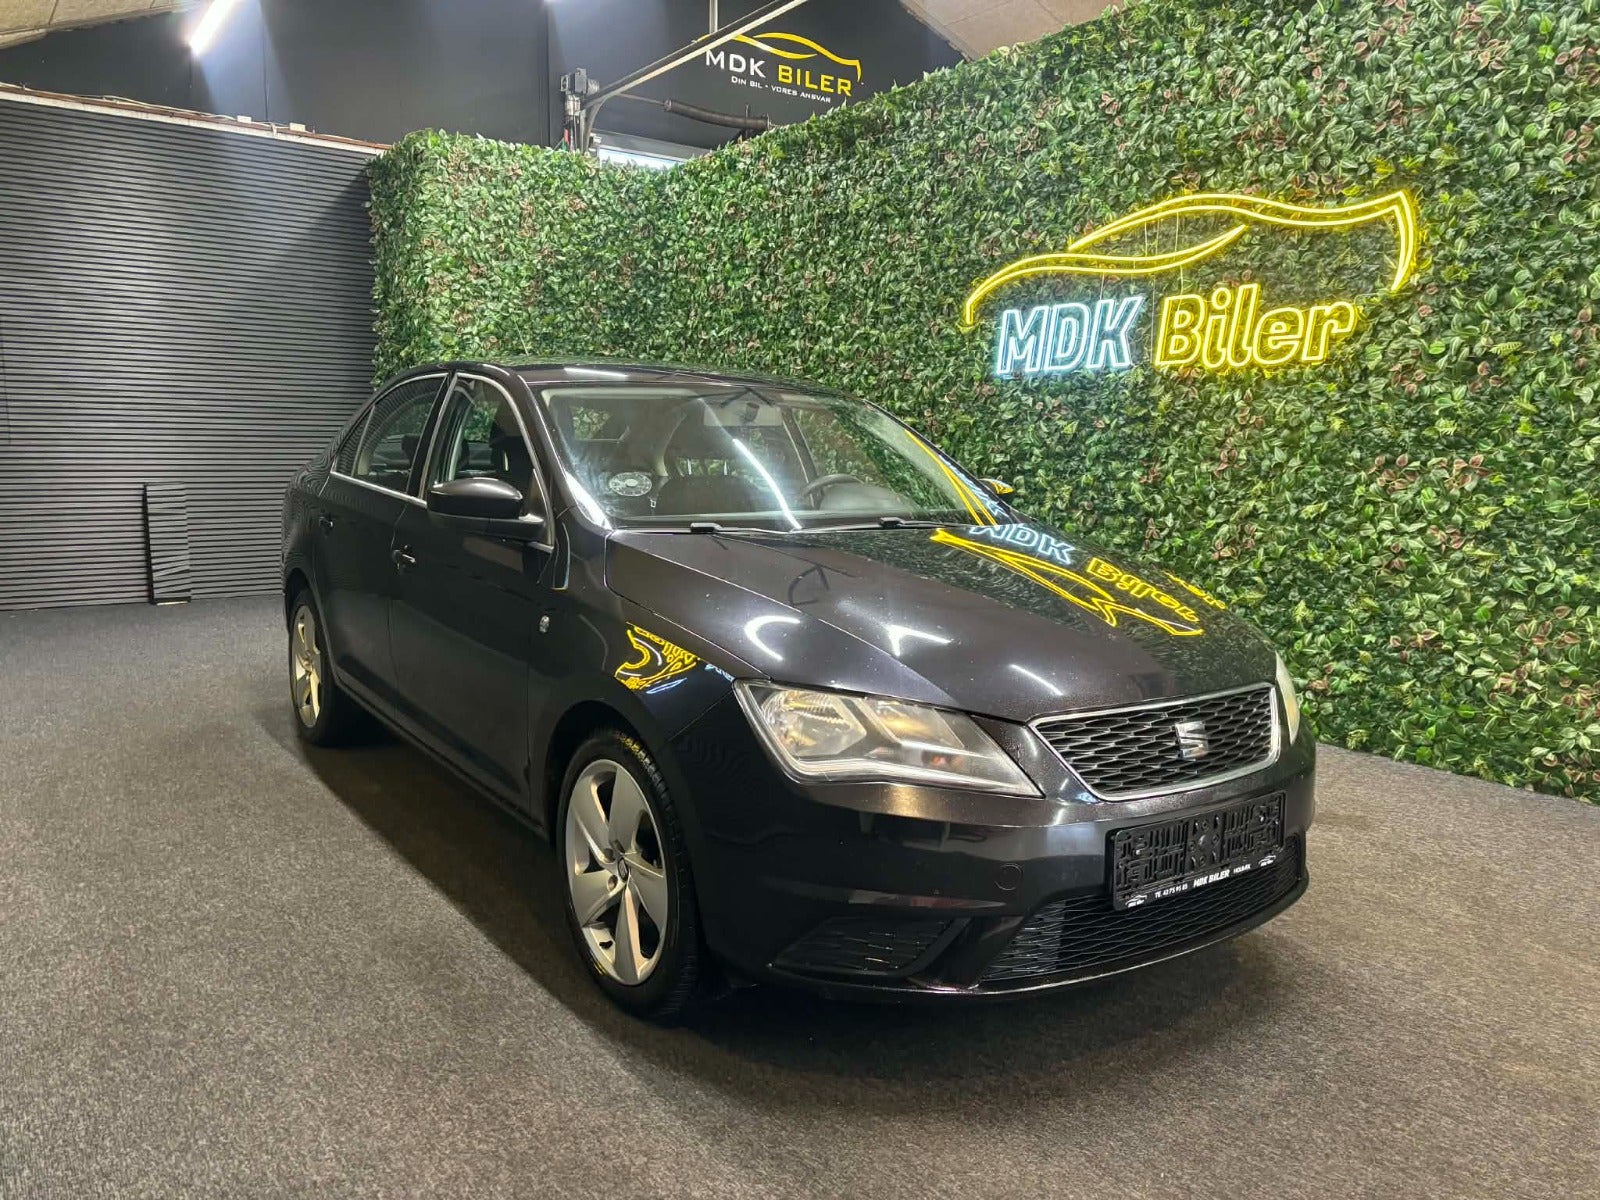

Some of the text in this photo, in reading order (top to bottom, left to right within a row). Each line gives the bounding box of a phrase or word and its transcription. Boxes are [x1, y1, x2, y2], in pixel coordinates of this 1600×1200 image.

[705, 50, 852, 96] MDK BILER
[996, 282, 1357, 375] MDK Biler
[1208, 869, 1230, 883] BILER
